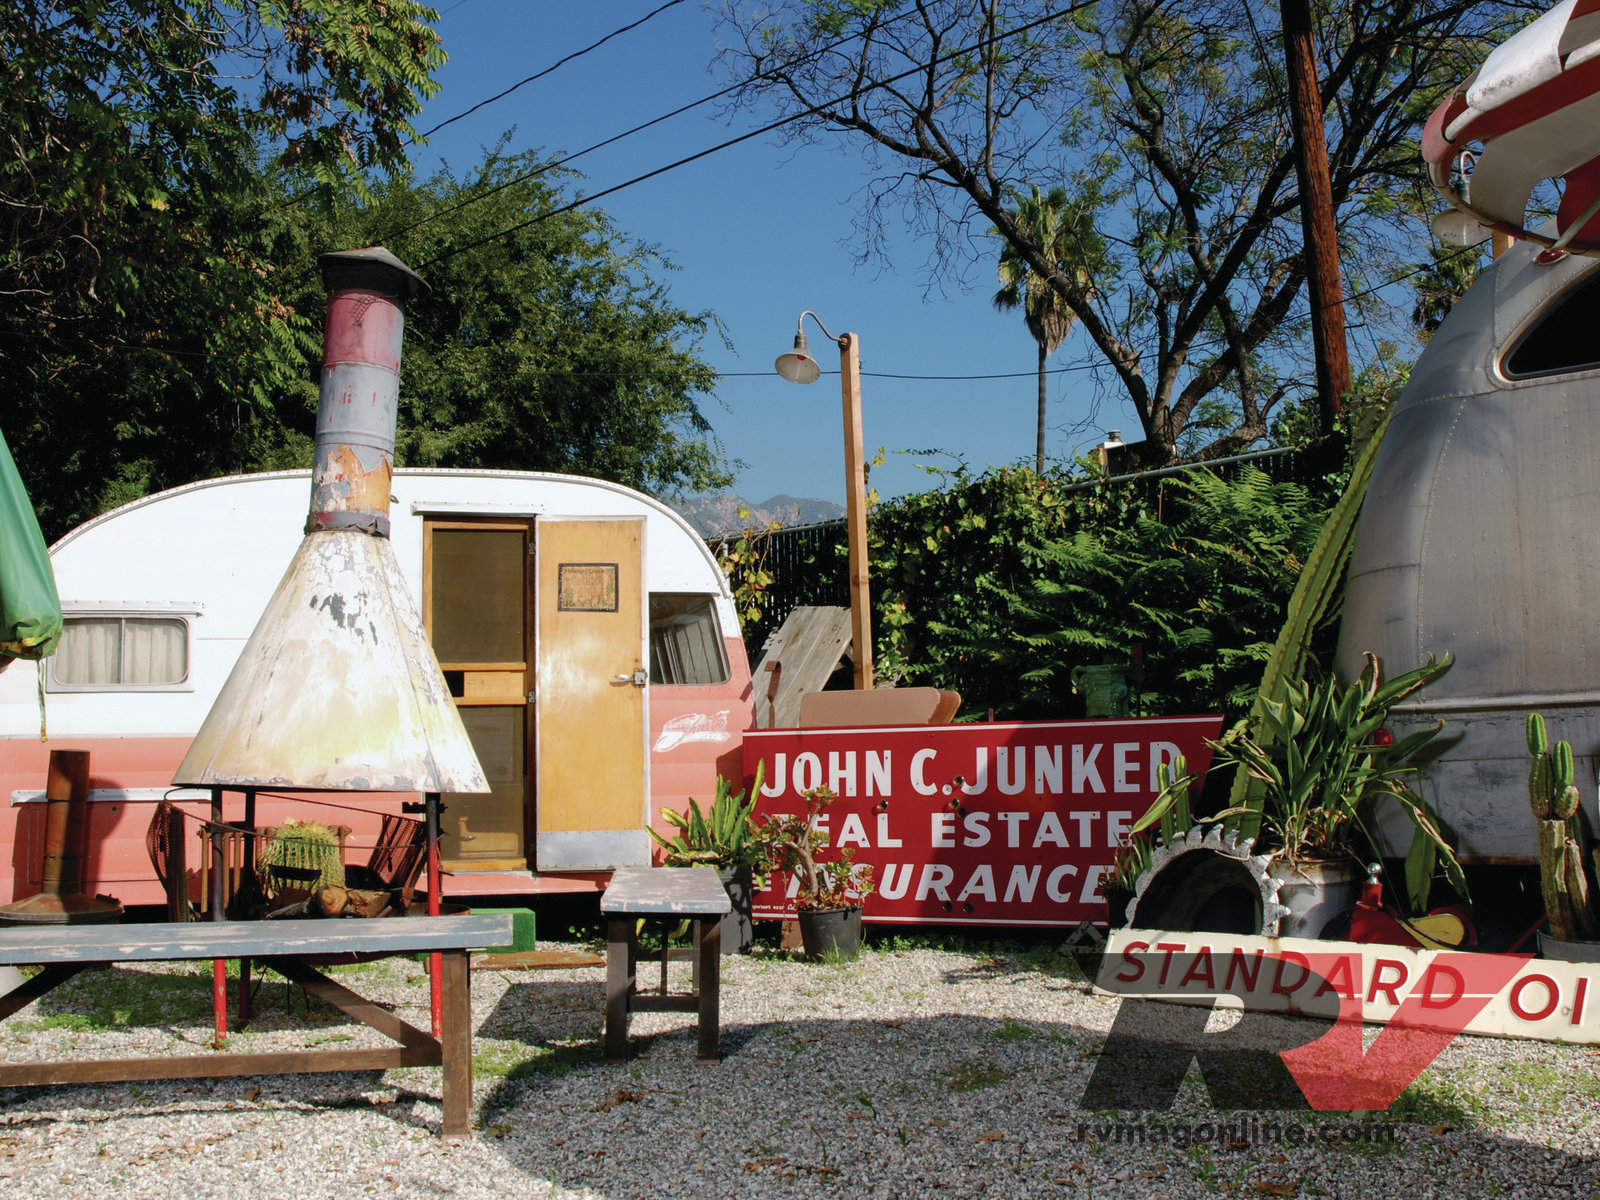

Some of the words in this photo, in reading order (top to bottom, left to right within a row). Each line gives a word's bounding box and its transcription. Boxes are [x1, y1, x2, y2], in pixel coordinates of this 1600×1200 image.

[760, 750, 892, 798] JOHN
[909, 748, 952, 796] C.
[771, 813, 902, 848] EAL
[931, 810, 1132, 848] ESTATE
[1115, 940, 1466, 1011] STANDARD
